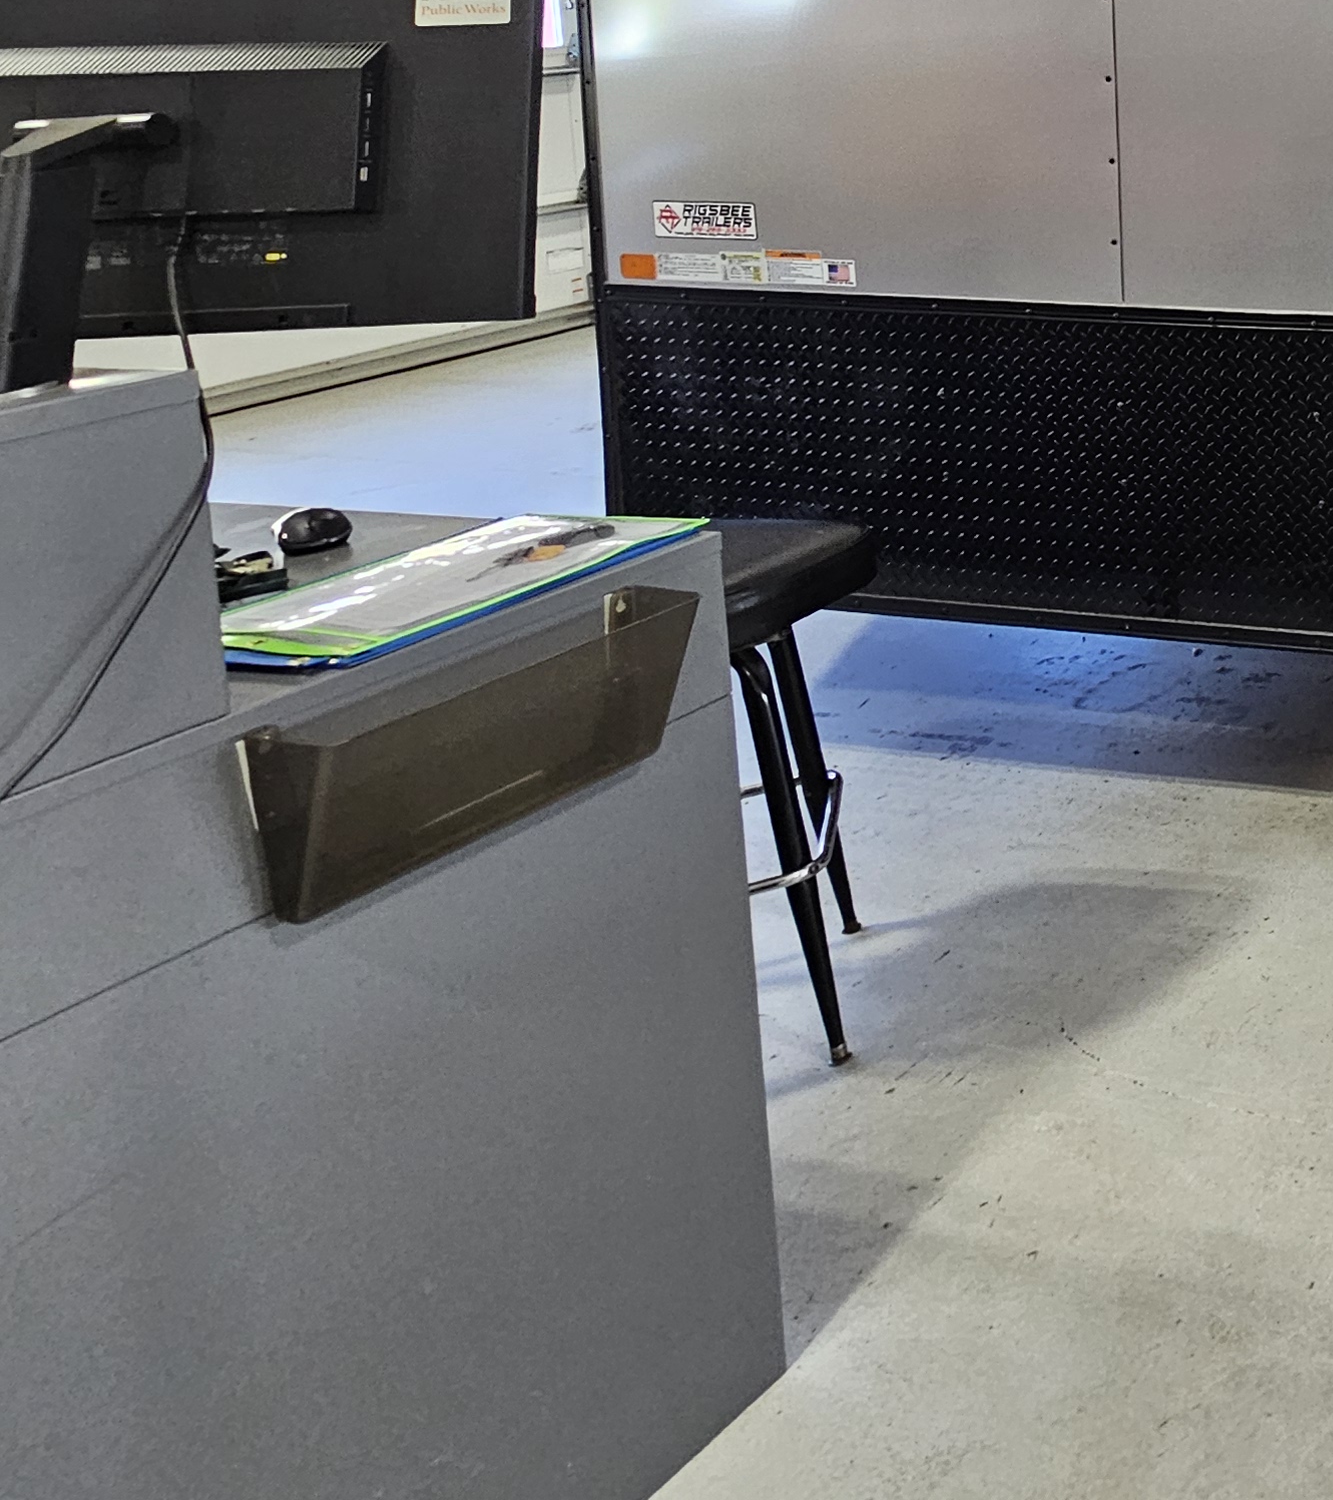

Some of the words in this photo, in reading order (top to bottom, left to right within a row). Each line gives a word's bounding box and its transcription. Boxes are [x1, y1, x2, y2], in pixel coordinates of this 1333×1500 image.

[421, 4, 462, 15] Public
[464, 3, 506, 15] Works
[682, 204, 752, 216] RIGSBEE
[682, 215, 753, 228] TRAILERS
